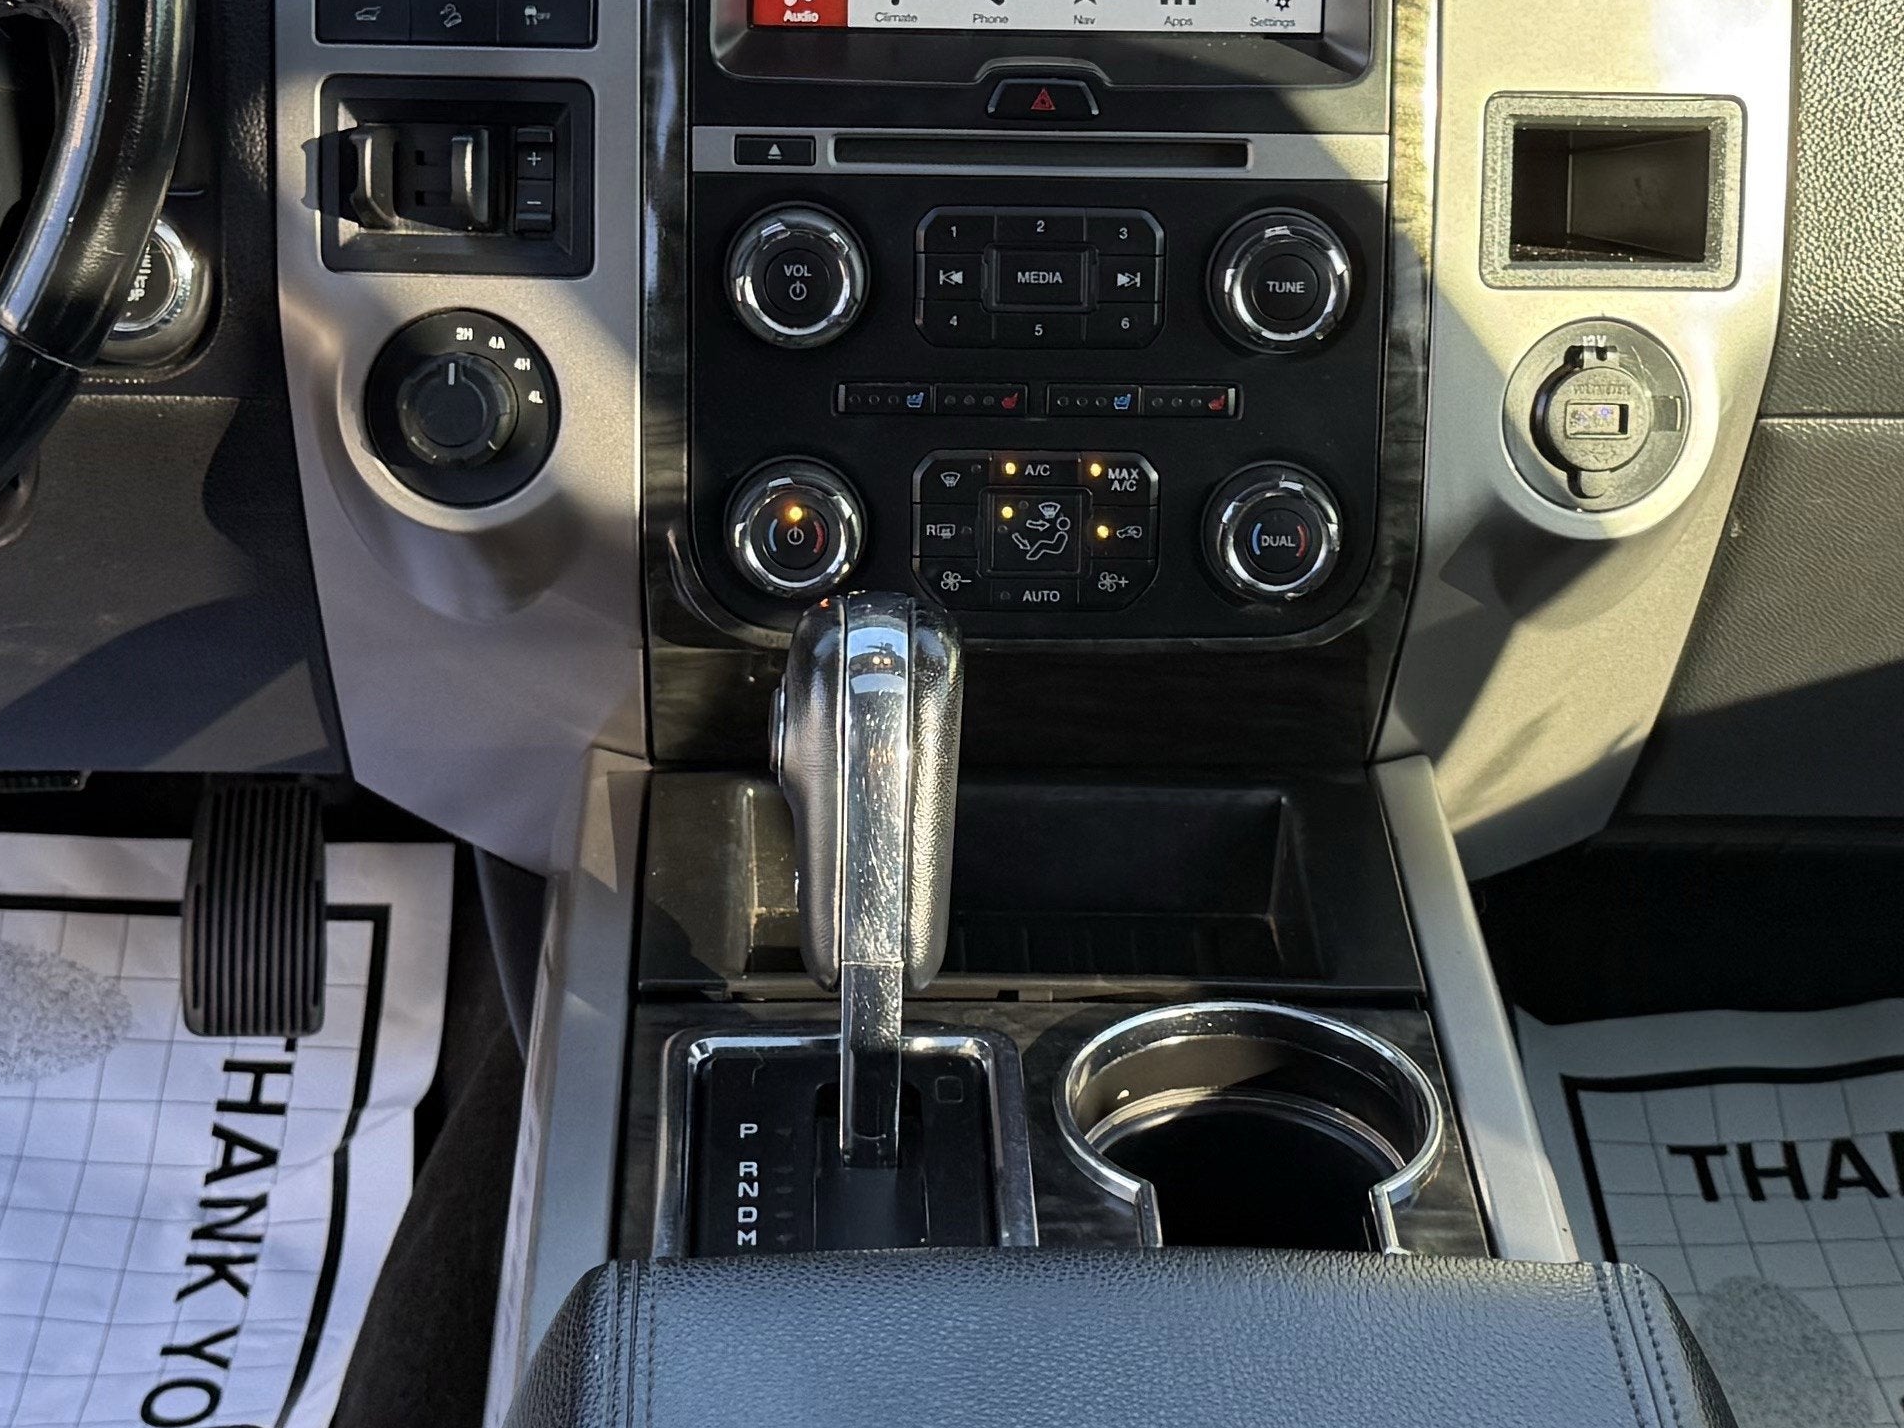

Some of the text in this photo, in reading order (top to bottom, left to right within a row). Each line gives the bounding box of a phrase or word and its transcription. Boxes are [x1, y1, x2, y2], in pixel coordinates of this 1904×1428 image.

[783, 10, 819, 23] Audio
[972, 13, 1009, 24] Phone
[1163, 16, 1193, 27] Apps
[1249, 16, 1296, 28] Settings
[950, 226, 957, 237] 1
[1036, 220, 1046, 233] 2
[1119, 227, 1129, 239] 3
[783, 264, 812, 279] VOL
[1017, 271, 1063, 284] MEDIA
[1267, 280, 1305, 294] TUNE
[949, 315, 958, 326] 4
[1121, 317, 1130, 329] 6
[456, 327, 473, 341] 2H
[1034, 324, 1043, 336] 5
[488, 336, 506, 350] 4A
[514, 358, 531, 371] 4H
[1025, 465, 1050, 477] A/C
[1107, 468, 1139, 480] MAX
[1111, 480, 1137, 492] A/C
[1261, 533, 1297, 549] DUAL
[1022, 590, 1060, 602] AUTO
[739, 1123, 758, 1139] P
[172, 1037, 296, 1303] HANK
[739, 1162, 759, 1177] R
[738, 1182, 759, 1198] N
[738, 1207, 758, 1223] D
[737, 1230, 757, 1246] M
